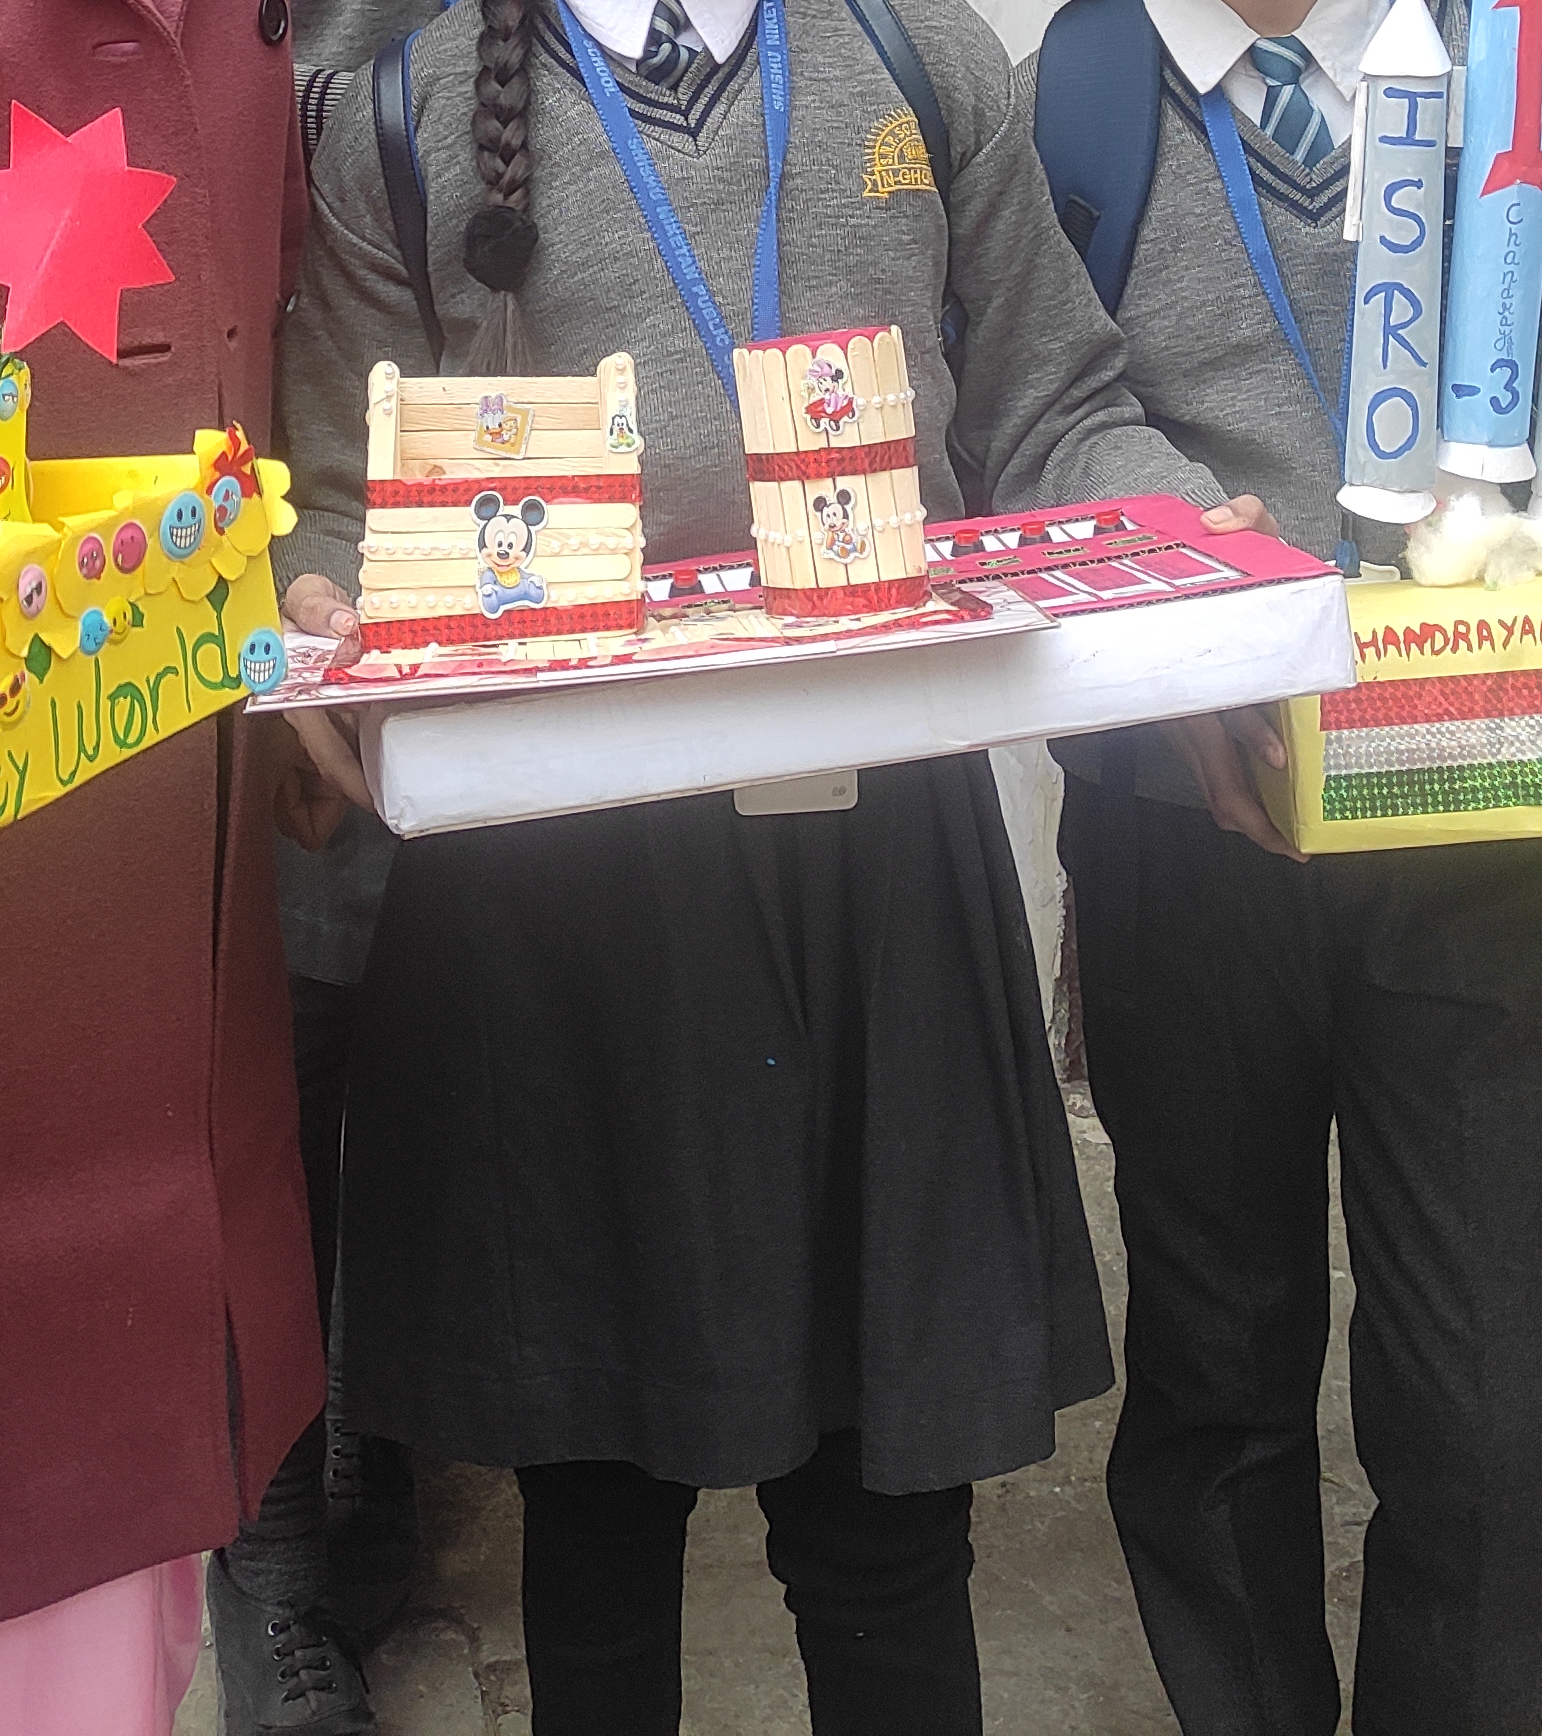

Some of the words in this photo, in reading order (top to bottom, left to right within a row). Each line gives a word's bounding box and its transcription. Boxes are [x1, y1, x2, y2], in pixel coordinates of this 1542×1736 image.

[582, 38, 616, 98] SCHOOL
[766, 50, 785, 113] SHISHU
[627, 136, 665, 202] SHISHU
[655, 204, 700, 281] NIKETAN
[691, 283, 733, 349] PUBLIC
[1362, 85, 1446, 461] ISRO
[50, 589, 242, 787] World
